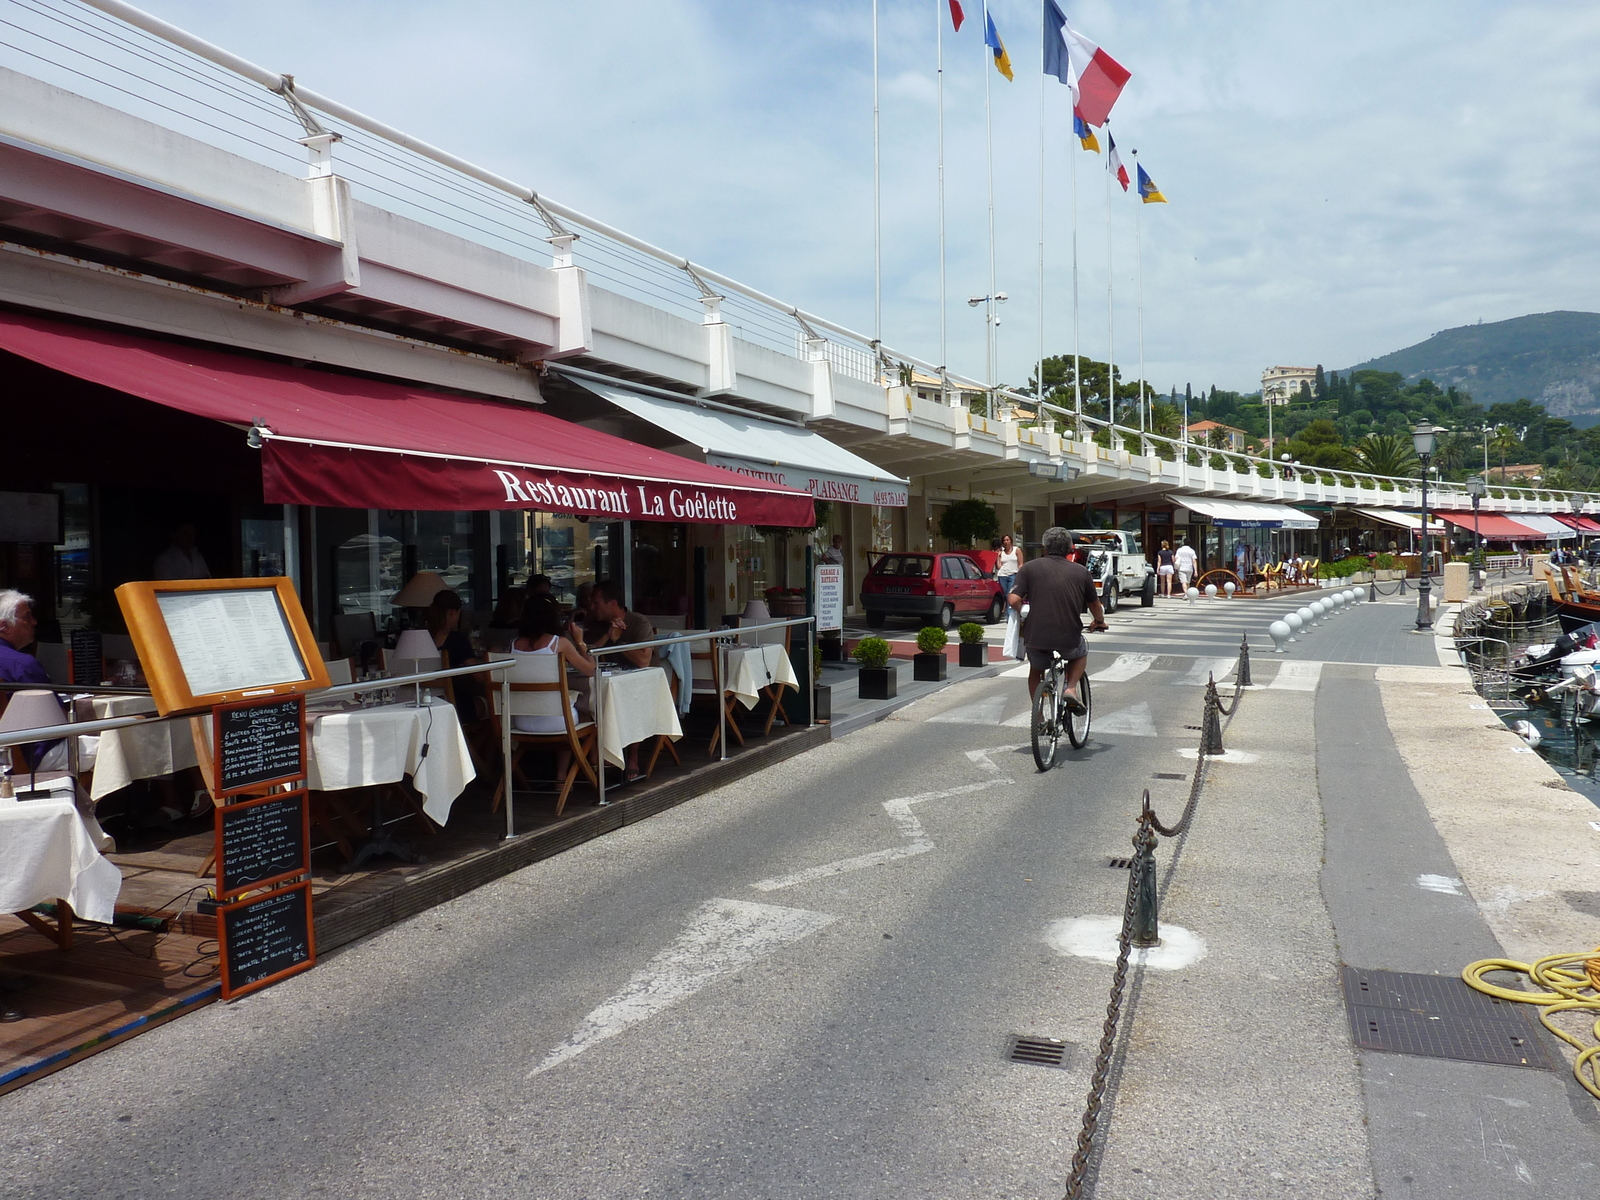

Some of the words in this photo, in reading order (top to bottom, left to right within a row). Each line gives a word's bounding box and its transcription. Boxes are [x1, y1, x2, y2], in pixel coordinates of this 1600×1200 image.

[493, 469, 630, 514] Restaurant
[636, 485, 665, 515] La
[669, 489, 737, 520] Goélette
[809, 479, 859, 501] PLAISANCE
